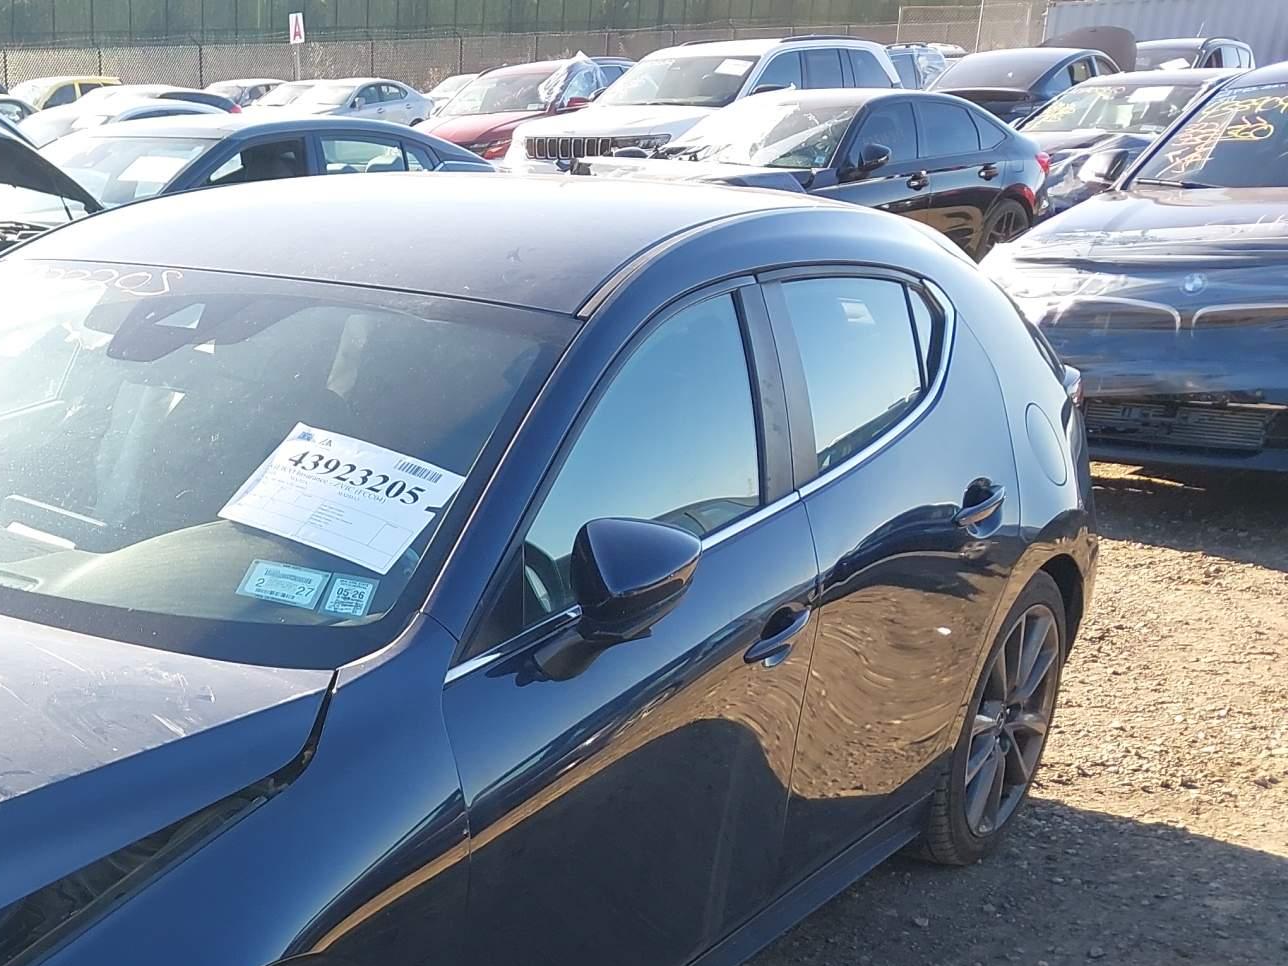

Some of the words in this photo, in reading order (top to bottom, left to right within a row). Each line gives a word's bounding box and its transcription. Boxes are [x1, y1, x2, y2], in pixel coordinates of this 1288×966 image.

[293, 14, 303, 41] A
[287, 450, 426, 505] 43923205
[255, 577, 265, 588] 2
[295, 586, 314, 597] 27
